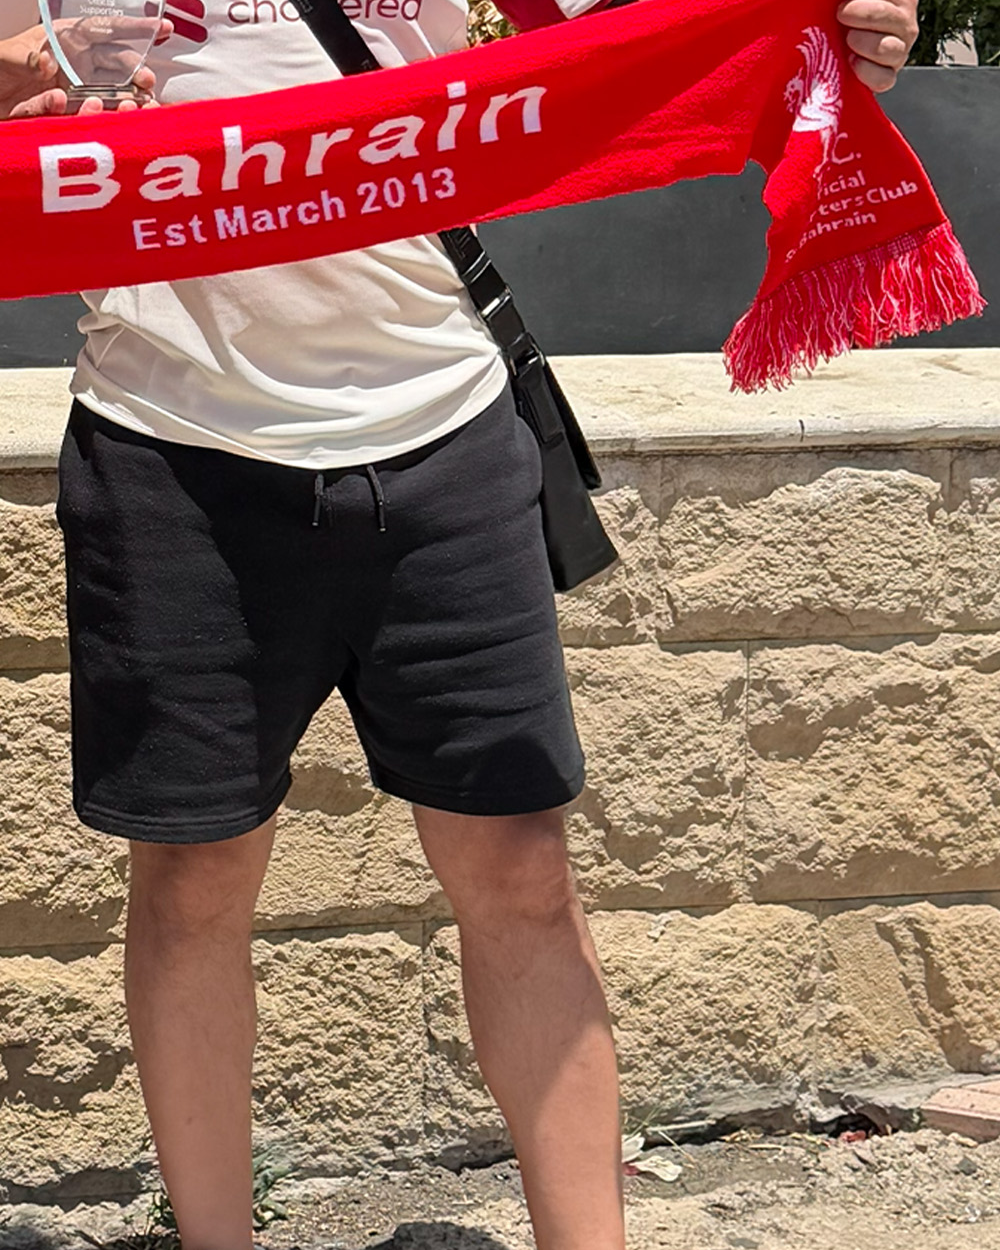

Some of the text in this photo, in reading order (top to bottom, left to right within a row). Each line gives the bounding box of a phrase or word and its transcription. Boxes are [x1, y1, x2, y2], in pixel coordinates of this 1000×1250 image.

[38, 80, 548, 214] Bahrain
[132, 166, 457, 250] Est March 2013
[823, 169, 866, 196] icial
[866, 180, 918, 203] Club
